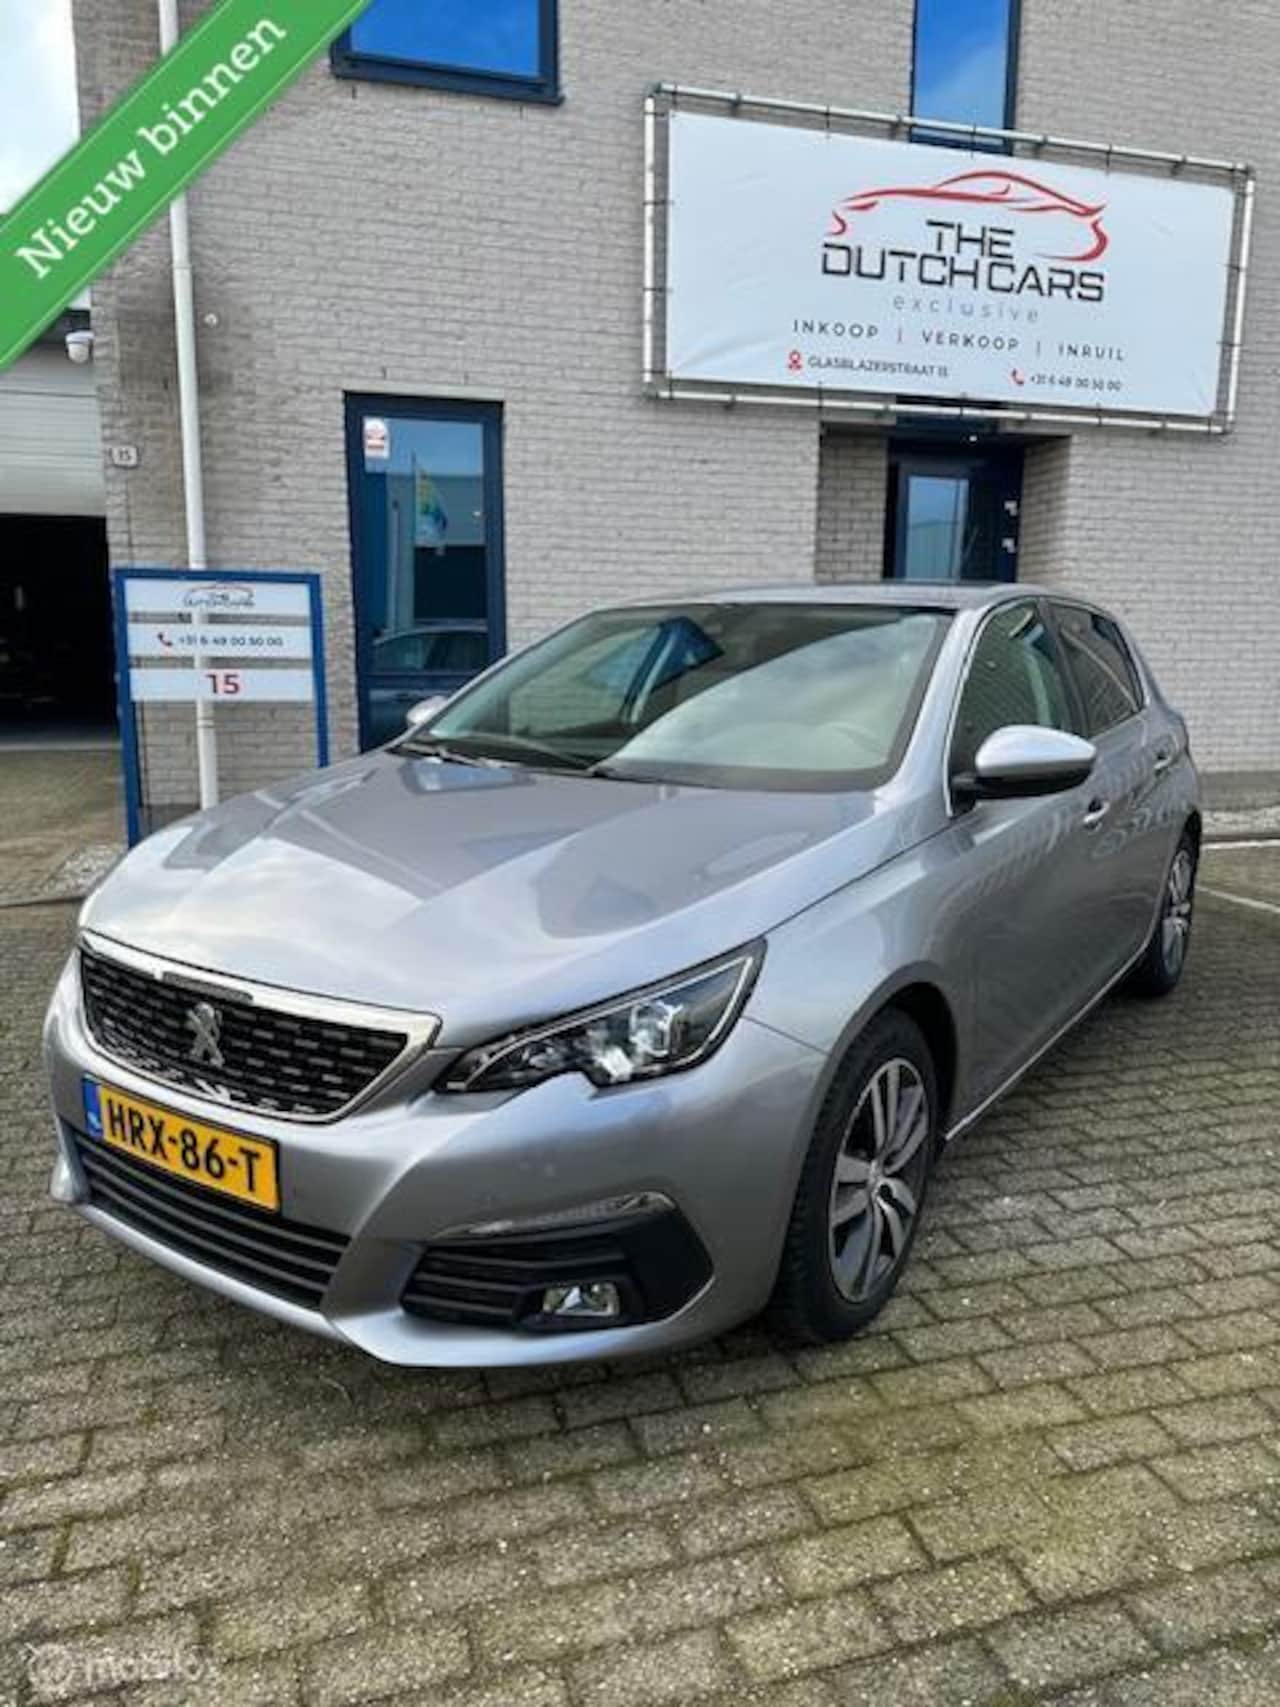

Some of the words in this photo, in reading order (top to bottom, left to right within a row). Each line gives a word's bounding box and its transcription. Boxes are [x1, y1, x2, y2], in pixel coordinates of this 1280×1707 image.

[926, 218, 1015, 260] THE
[892, 295, 1039, 323] exclusive
[793, 319, 879, 339] INKOOP
[921, 330, 1019, 351] VERKOOP
[1059, 343, 1124, 361] INRUIL
[205, 673, 240, 695] 15
[106, 1098, 261, 1194] HRX-86-T
